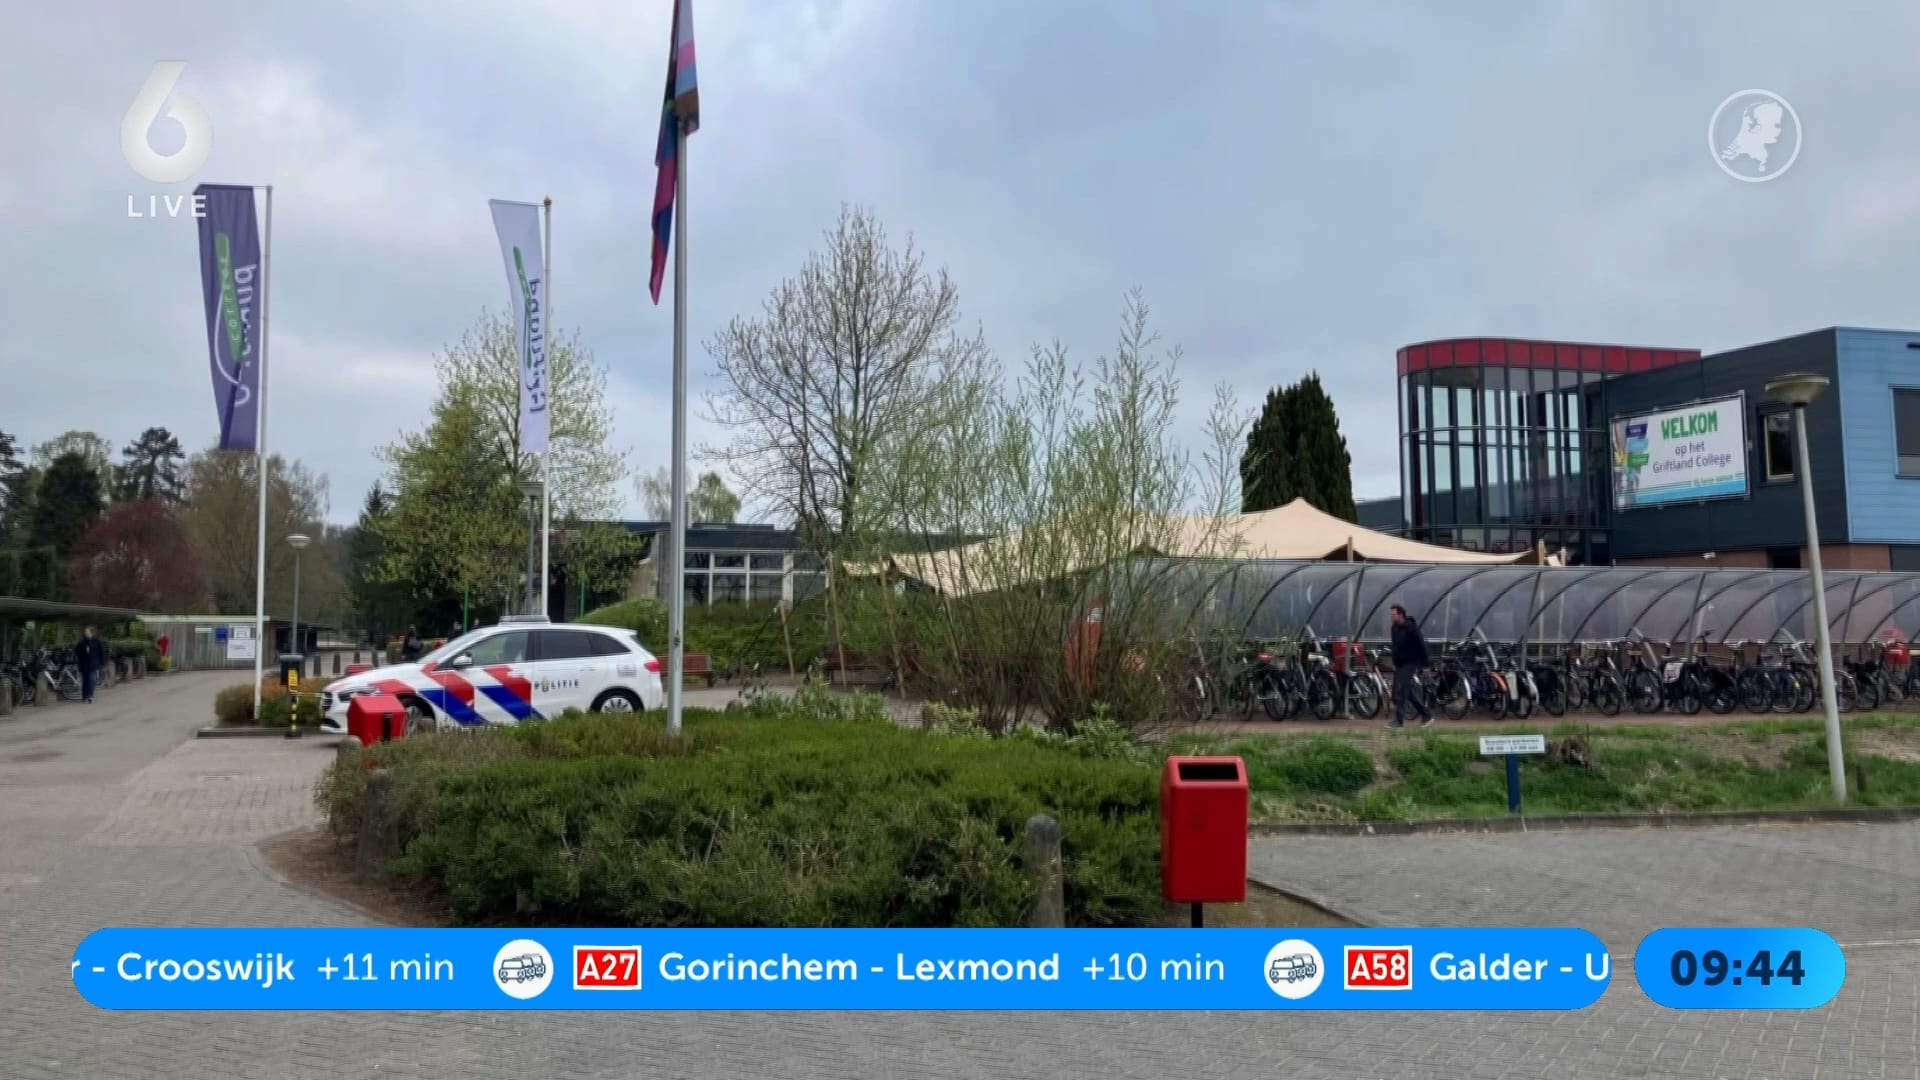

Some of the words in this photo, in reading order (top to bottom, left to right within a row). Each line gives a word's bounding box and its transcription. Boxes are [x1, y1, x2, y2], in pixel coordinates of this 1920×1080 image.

[1661, 410, 1718, 440] WELKOM
[1675, 445, 1688, 457] op
[1689, 441, 1705, 453] het
[1652, 459, 1694, 474] Griftland
[1696, 453, 1732, 468] College
